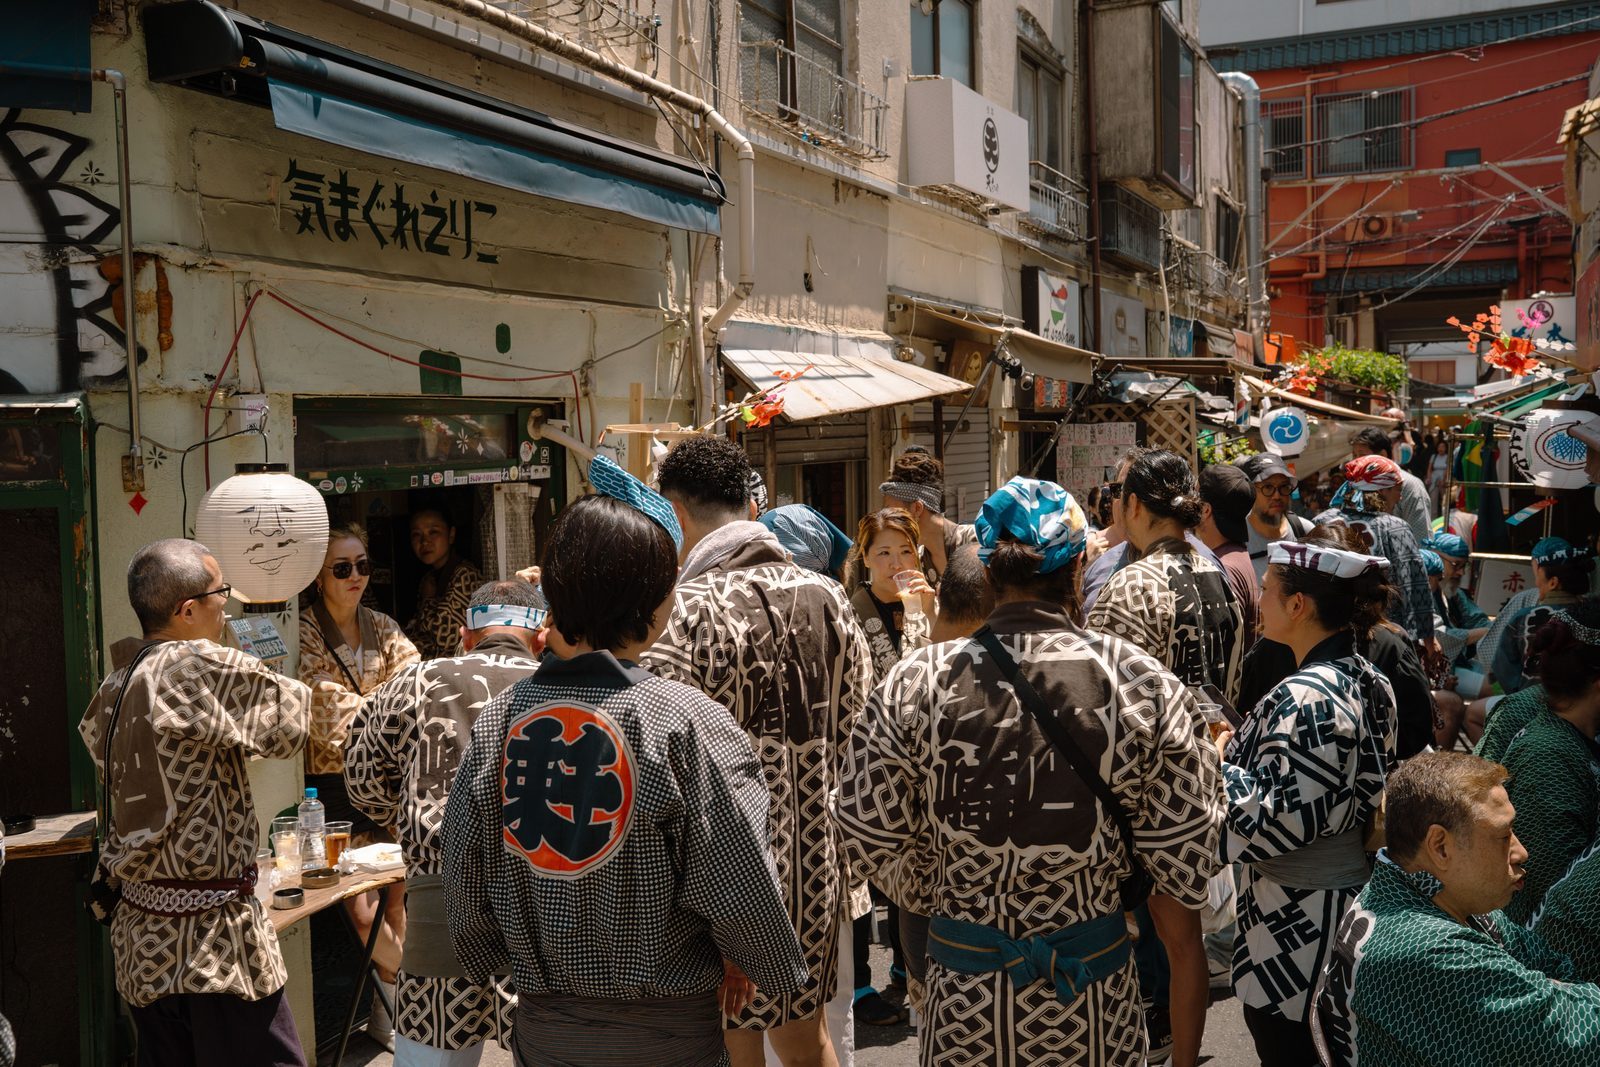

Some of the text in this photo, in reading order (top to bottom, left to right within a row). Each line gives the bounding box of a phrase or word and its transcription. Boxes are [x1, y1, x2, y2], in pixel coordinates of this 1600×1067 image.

[282, 158, 499, 264] 気まぐれえりこ
